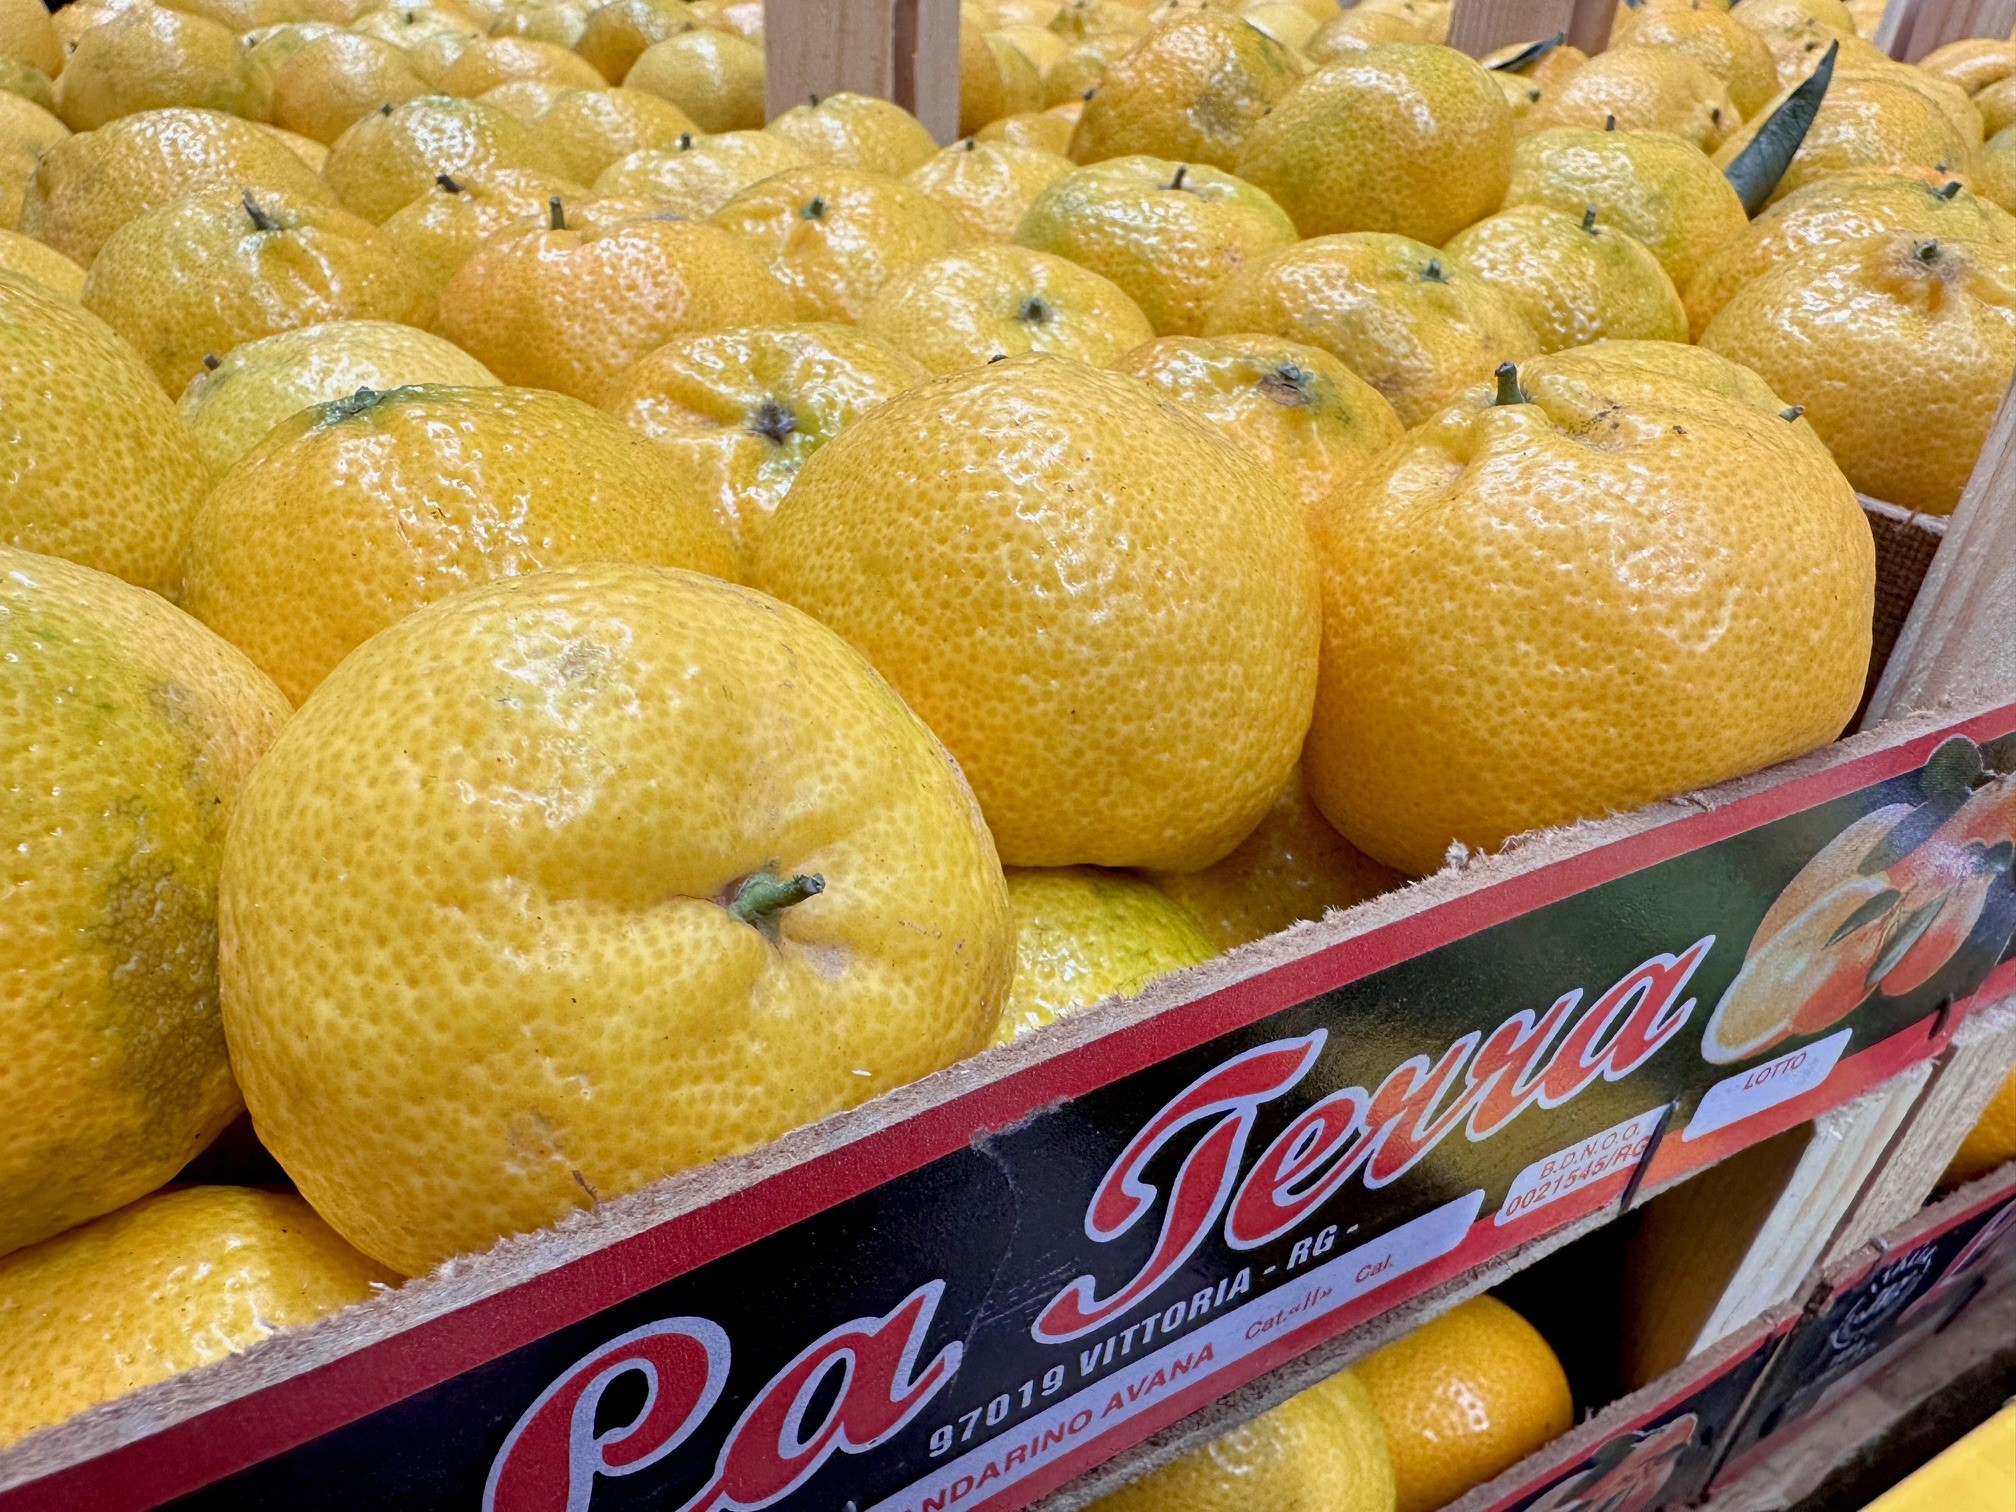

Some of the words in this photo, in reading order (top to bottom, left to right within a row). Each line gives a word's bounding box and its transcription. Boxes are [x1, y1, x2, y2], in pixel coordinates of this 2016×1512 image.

[1031, 934, 1717, 1345] Terra
[1744, 1052, 1808, 1091] LOTTO
[1506, 1136, 1650, 1216] 0021545/RG
[1539, 1123, 1641, 1180] B.D.N.O.O.
[904, 1409, 1093, 1512] NDARINO
[1101, 1342, 1214, 1418] AVANA
[1355, 1253, 1393, 1283] Cal.
[928, 1363, 1066, 1458] 97019
[1079, 1266, 1251, 1377] VITTORIA
[1286, 1224, 1338, 1272] RG
